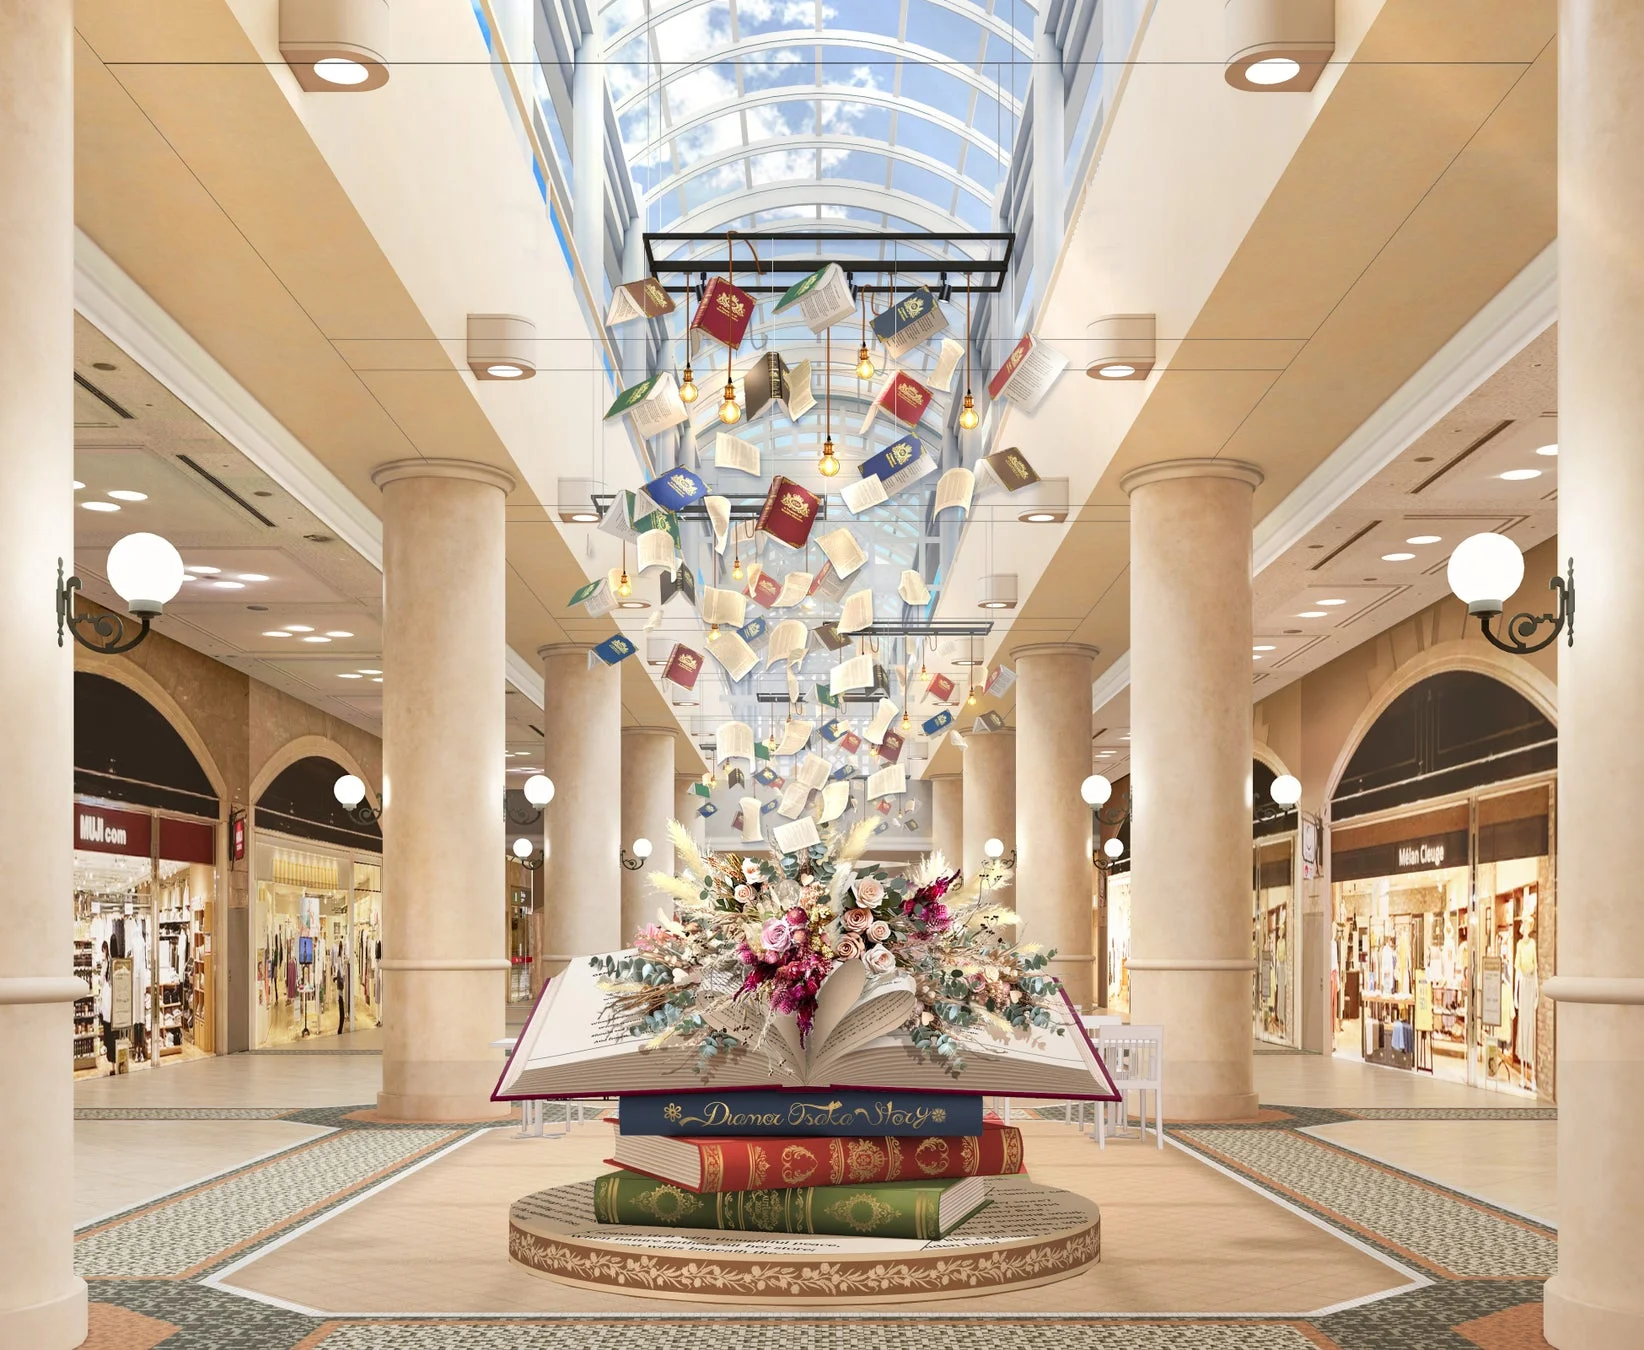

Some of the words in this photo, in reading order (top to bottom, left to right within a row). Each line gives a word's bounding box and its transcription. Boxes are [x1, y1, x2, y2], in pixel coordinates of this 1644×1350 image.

[79, 814, 104, 843] MUJI
[105, 827, 127, 845] com
[854, 1100, 932, 1129] Story
